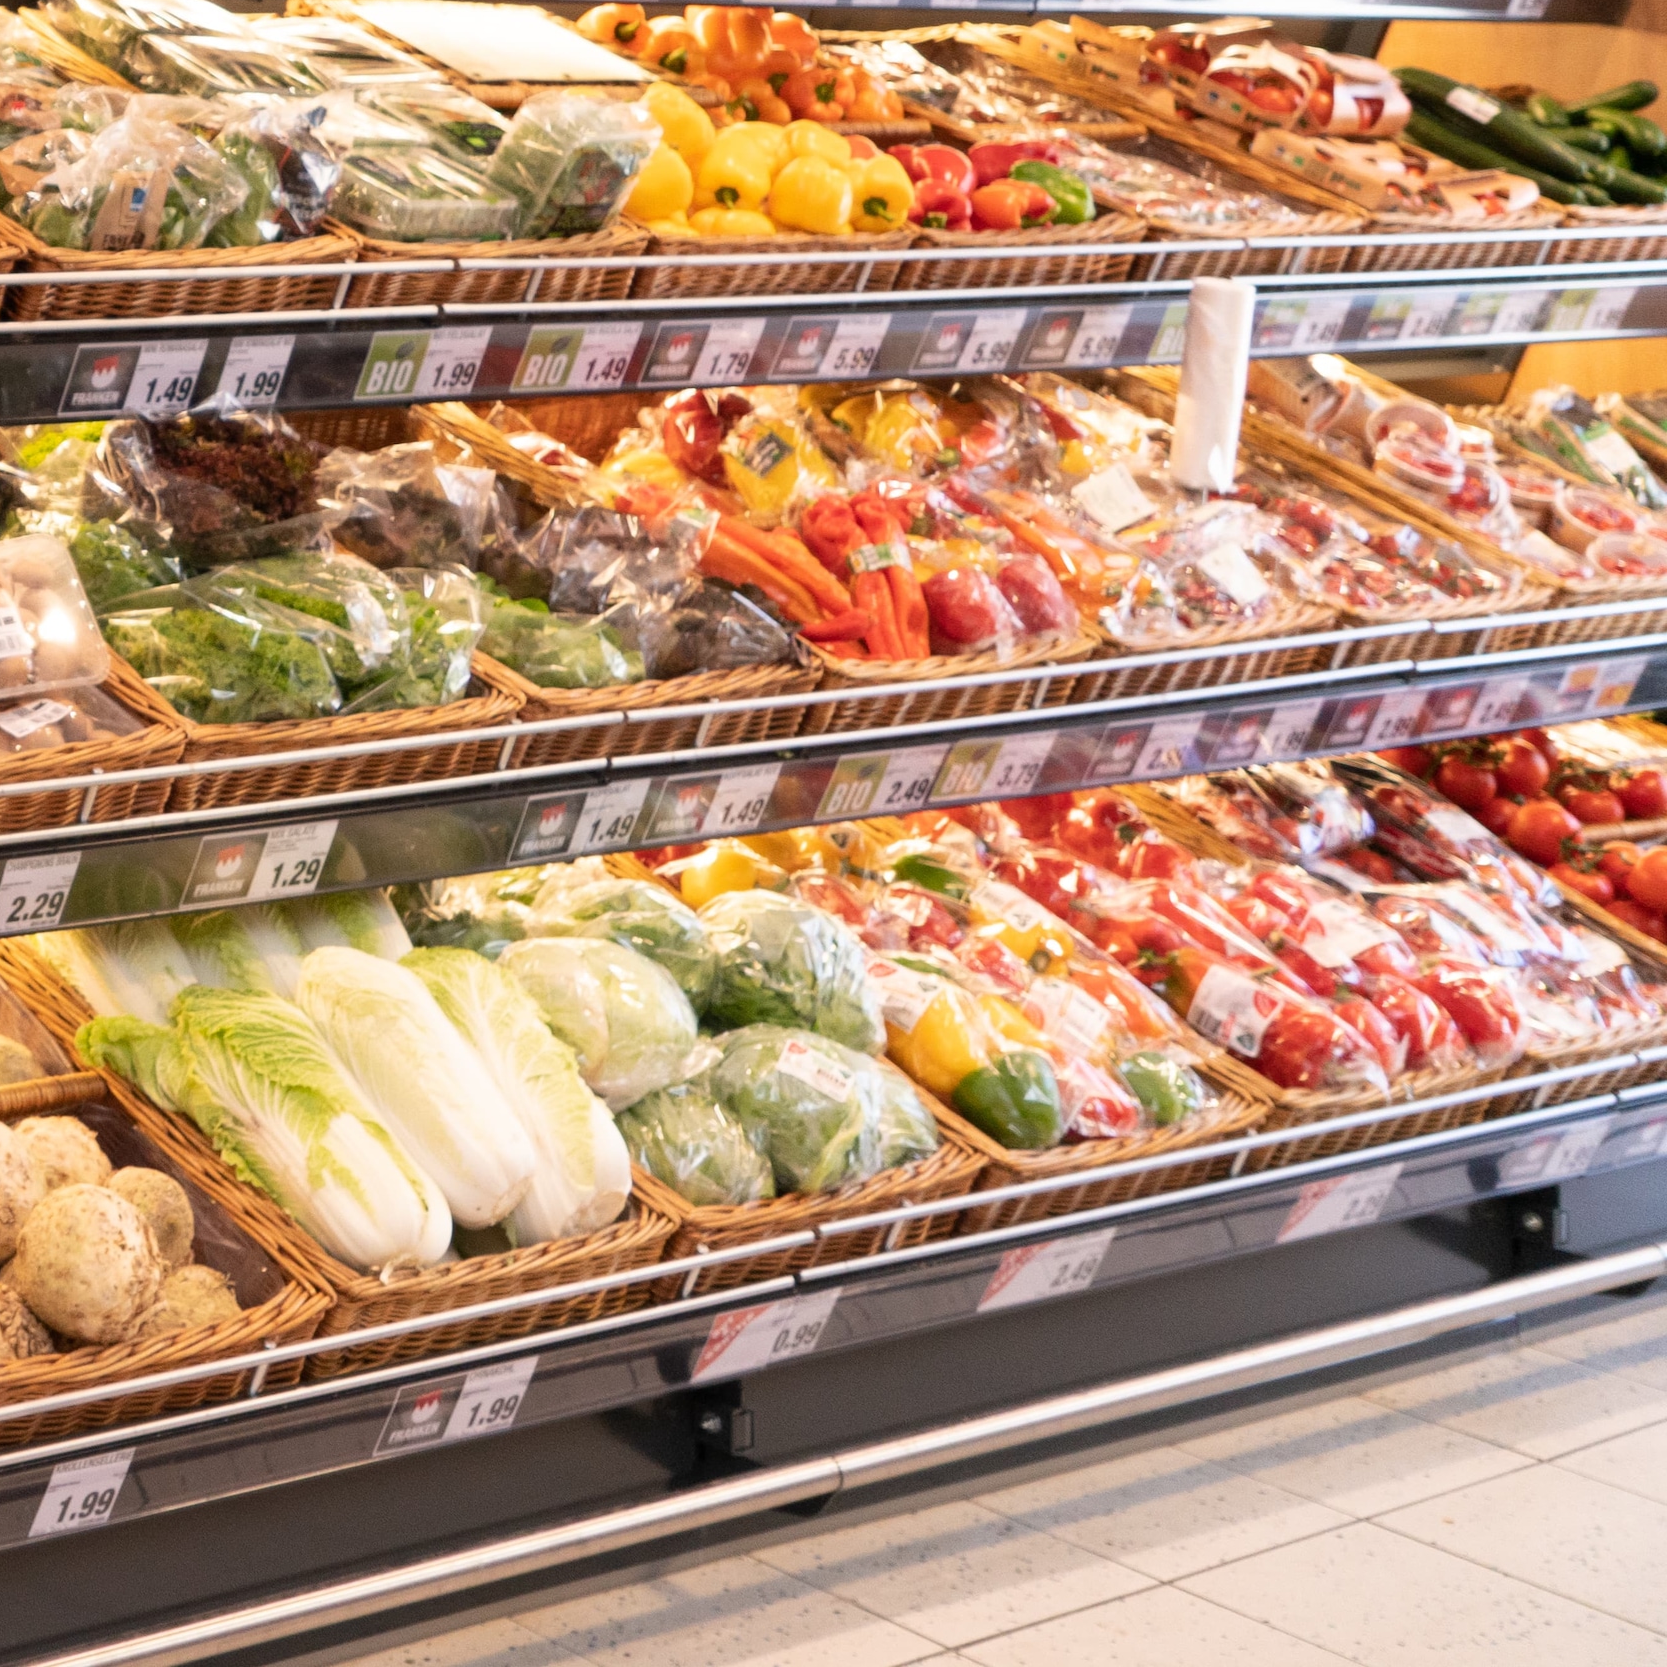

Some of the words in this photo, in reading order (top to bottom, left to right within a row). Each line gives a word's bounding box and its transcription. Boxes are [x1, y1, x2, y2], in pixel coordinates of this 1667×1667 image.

[368, 360, 414, 394] BIO
[433, 362, 476, 387] 1.99
[522, 353, 568, 386] BIO
[585, 357, 627, 382] 1.49
[709, 352, 750, 375] 1.79
[145, 376, 193, 404] 1.49
[234, 371, 281, 397] 1.99
[828, 779, 874, 814] BIO
[884, 777, 931, 805] 2.49
[721, 799, 766, 826] 1.49
[588, 815, 634, 844] 1.49
[271, 858, 321, 889] 1.29
[6, 890, 65, 923] 2.29
[468, 1393, 520, 1428] 1.99
[389, 1421, 442, 1444] FRANKEN
[55, 1488, 116, 1523] 1.99
